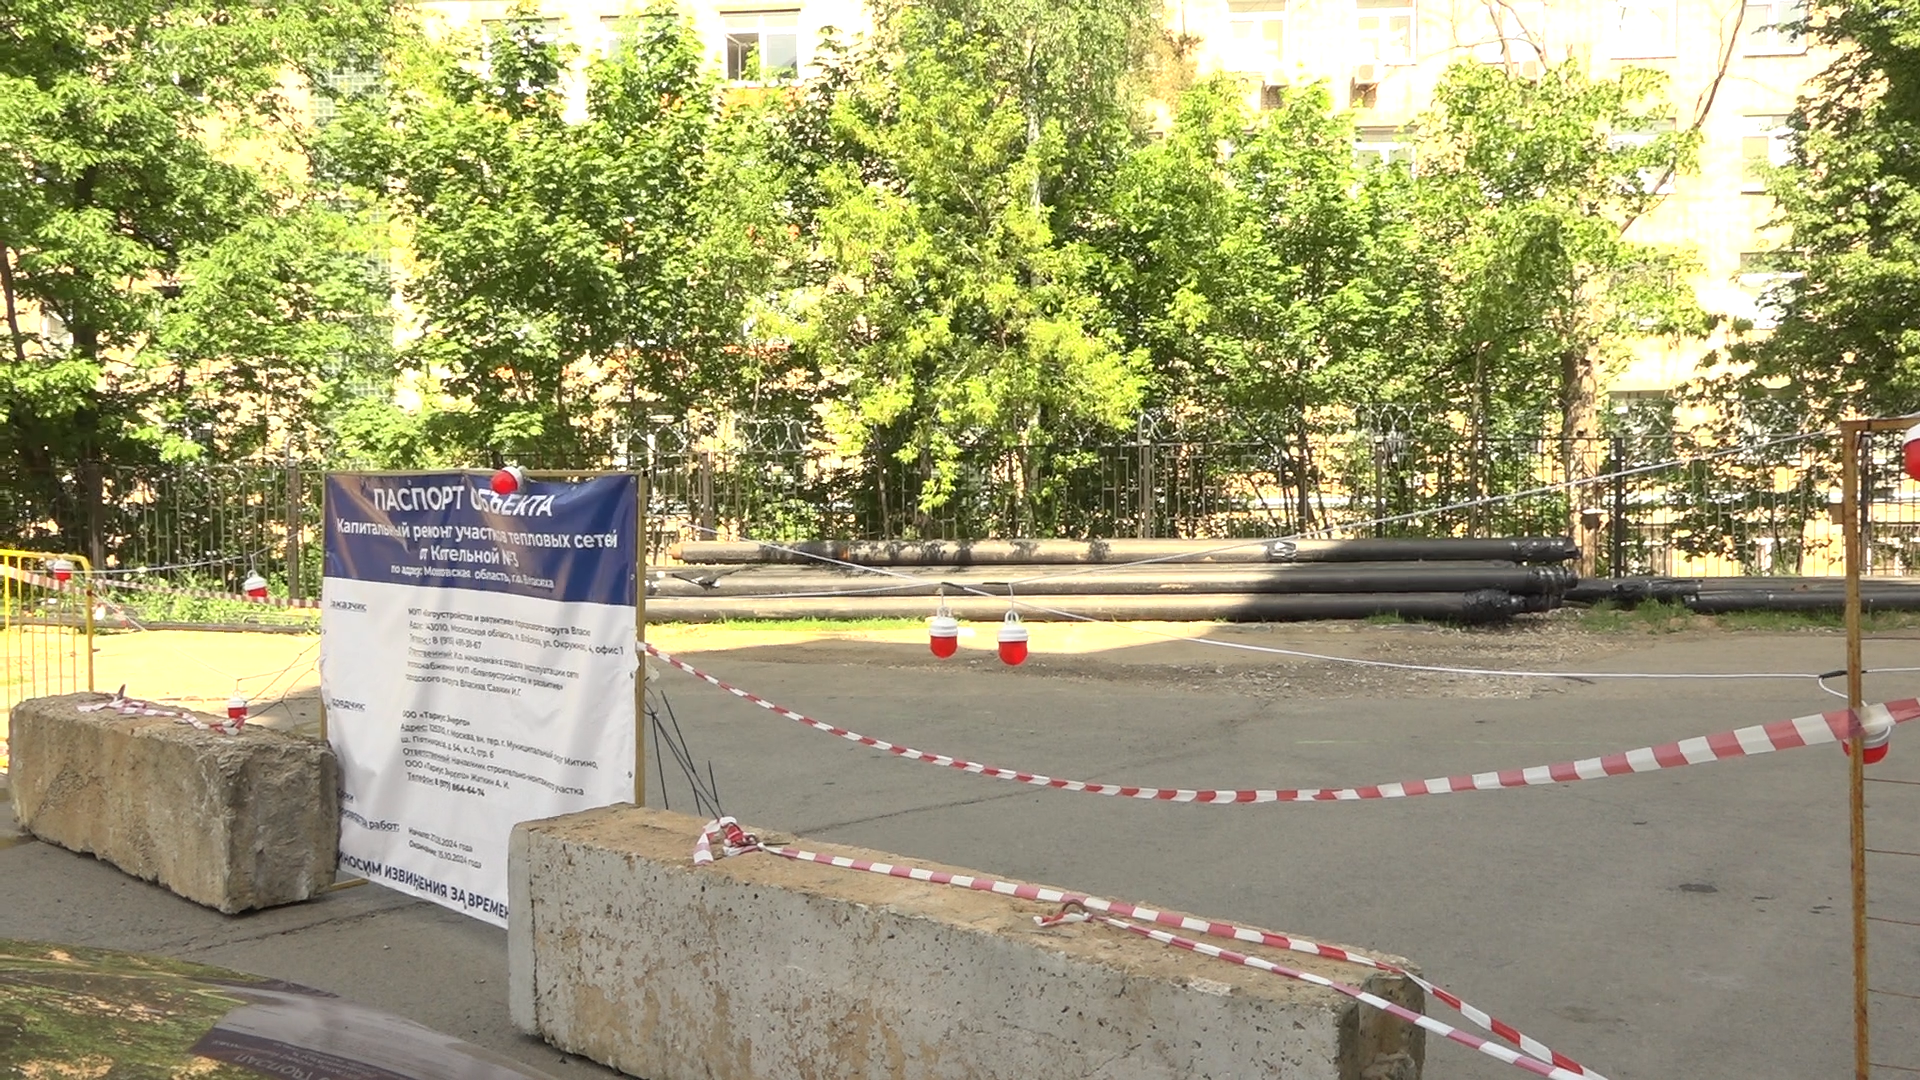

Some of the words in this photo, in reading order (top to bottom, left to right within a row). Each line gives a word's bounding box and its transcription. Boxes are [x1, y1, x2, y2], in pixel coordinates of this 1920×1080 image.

[373, 485, 465, 511] ПАСПОРТ
[507, 531, 571, 548] тепловых
[595, 645, 618, 655] офис
[405, 760, 423, 768] ООО
[369, 819, 400, 832] работ:
[451, 887, 466, 905] ЗА
